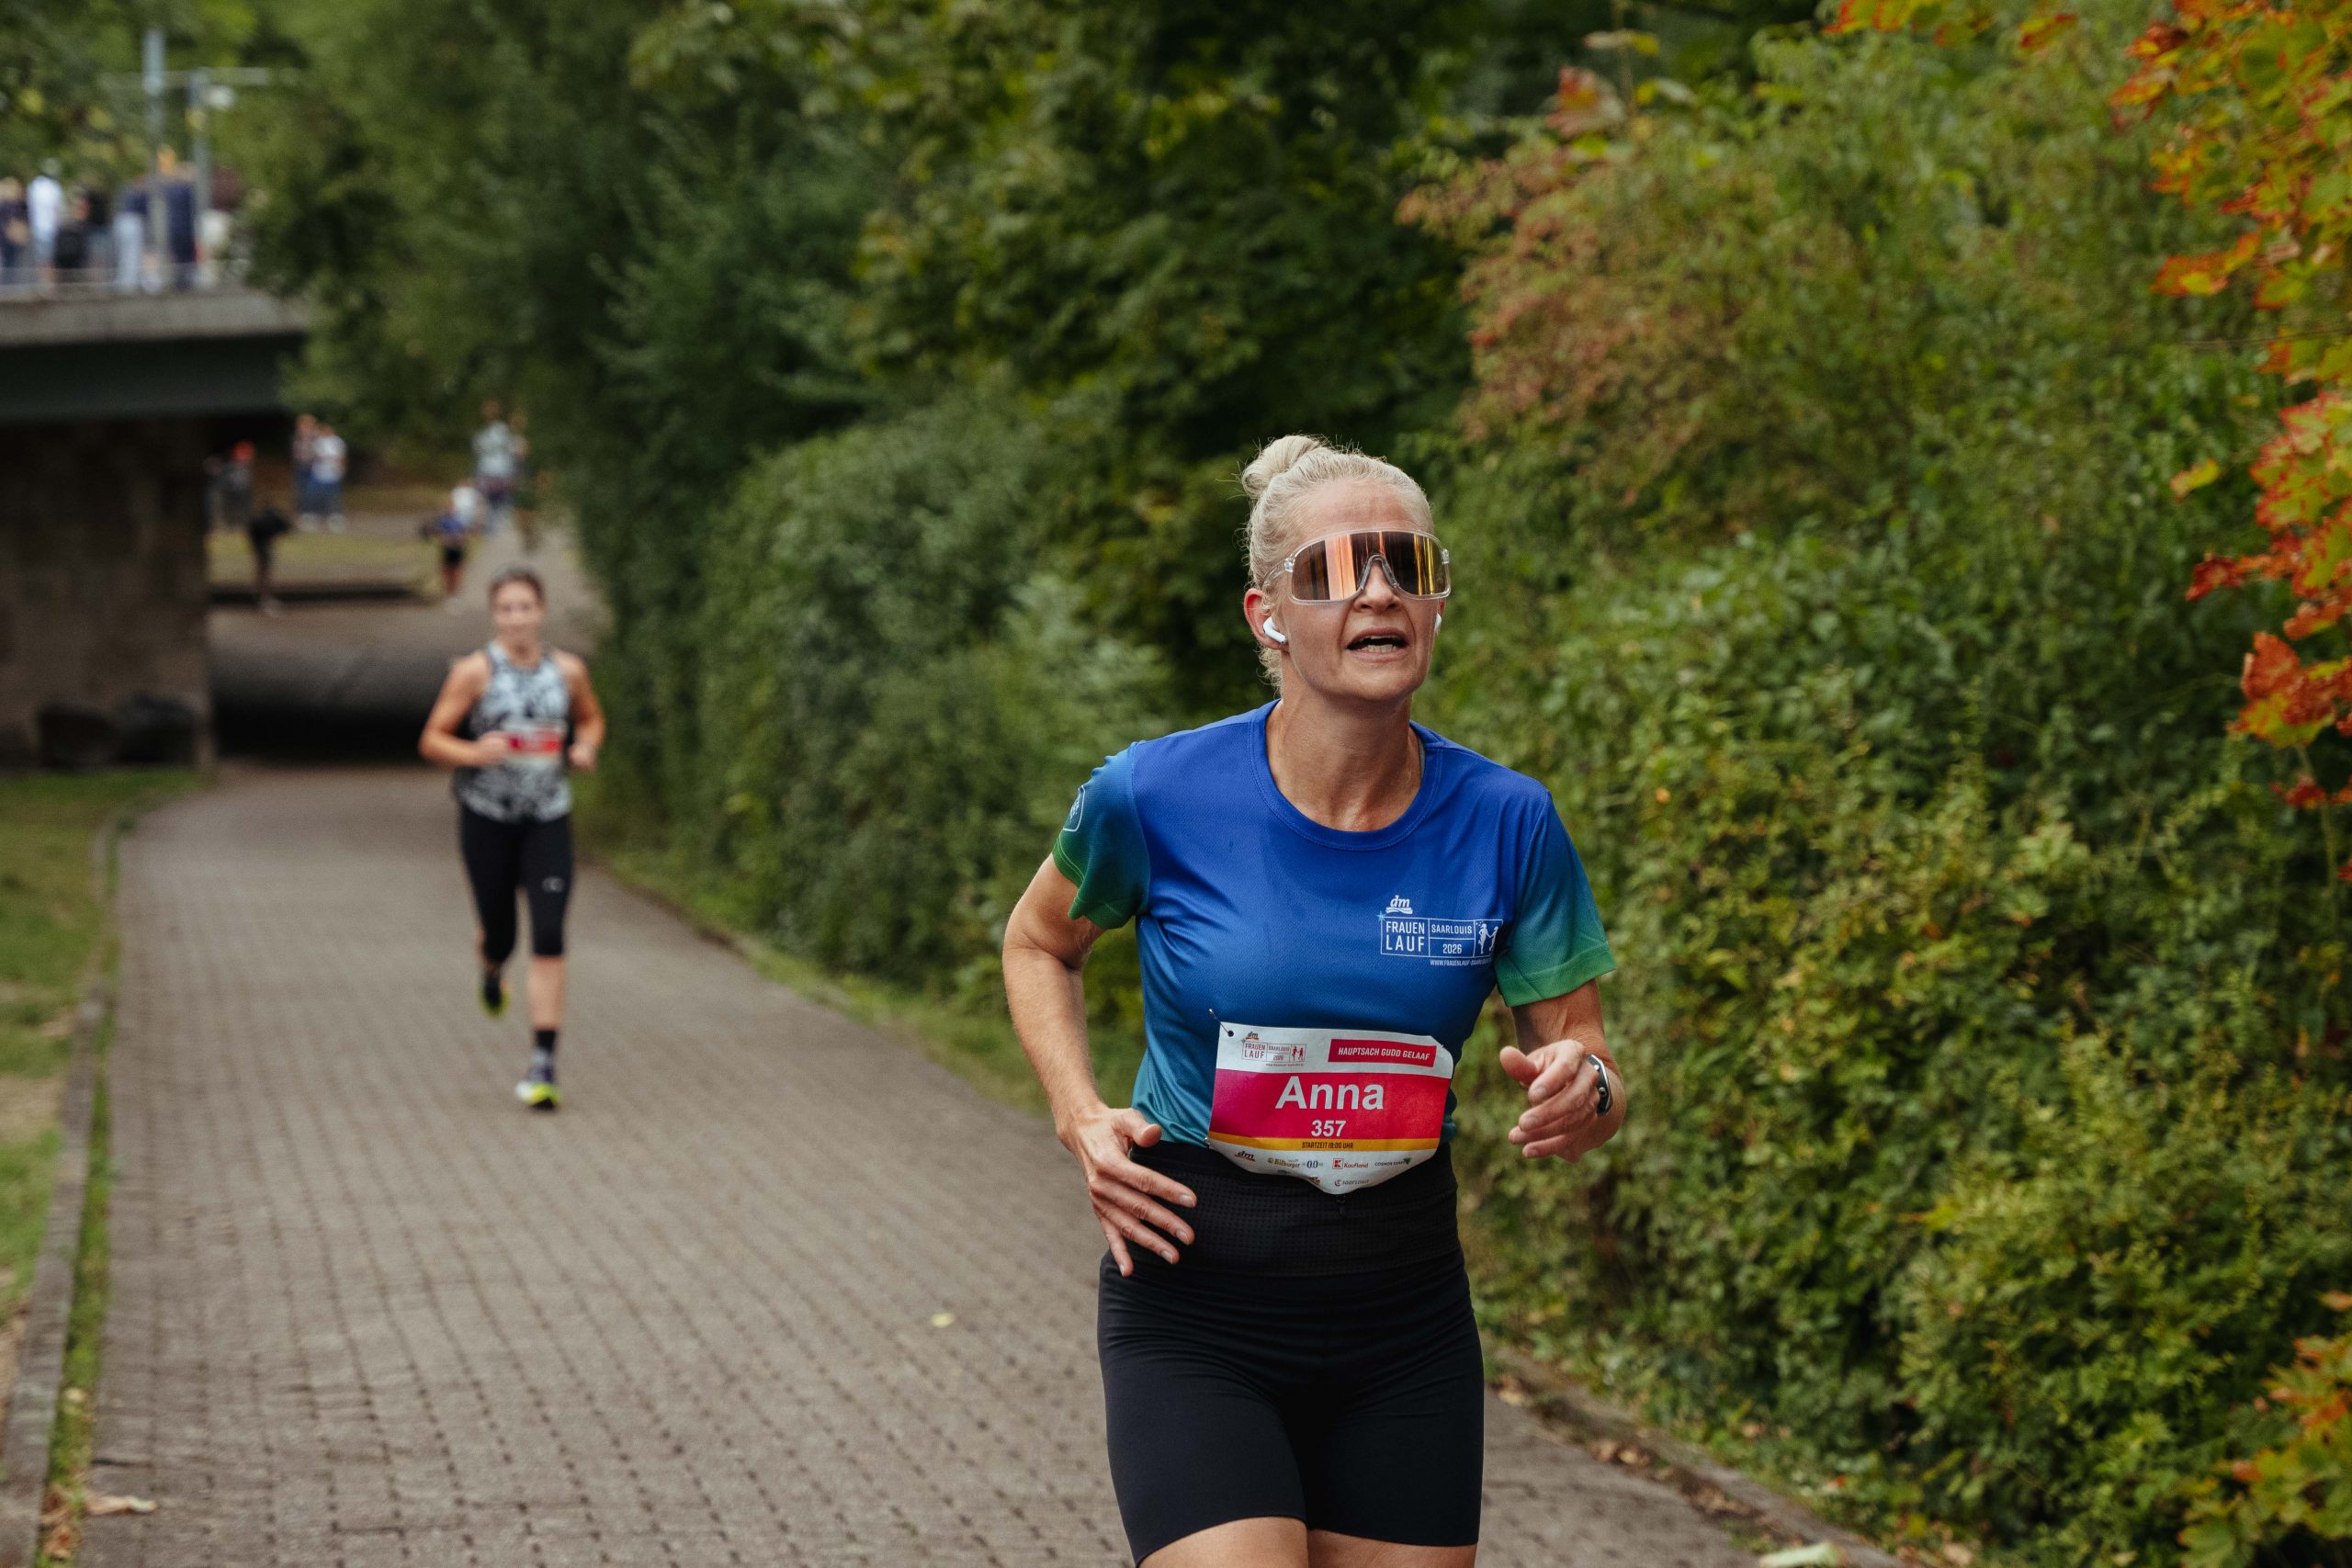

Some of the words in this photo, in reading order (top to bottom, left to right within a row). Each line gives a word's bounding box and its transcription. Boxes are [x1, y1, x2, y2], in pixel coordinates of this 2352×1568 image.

[1390, 895, 1409, 908] dm
[1385, 920, 1425, 934] FRAUEN
[1430, 924, 1473, 934] SAARLOUIS
[1385, 934, 1425, 952] LAUF
[1442, 943, 1463, 954] 2026
[1245, 1043, 1266, 1051] FRAUEN
[1338, 1046, 1380, 1056] HAUPTSACH
[1402, 1052, 1430, 1061] GELAAF
[1244, 1050, 1265, 1059] LAUF
[1274, 1076, 1384, 1111] Anna
[1310, 1119, 1347, 1137] 357
